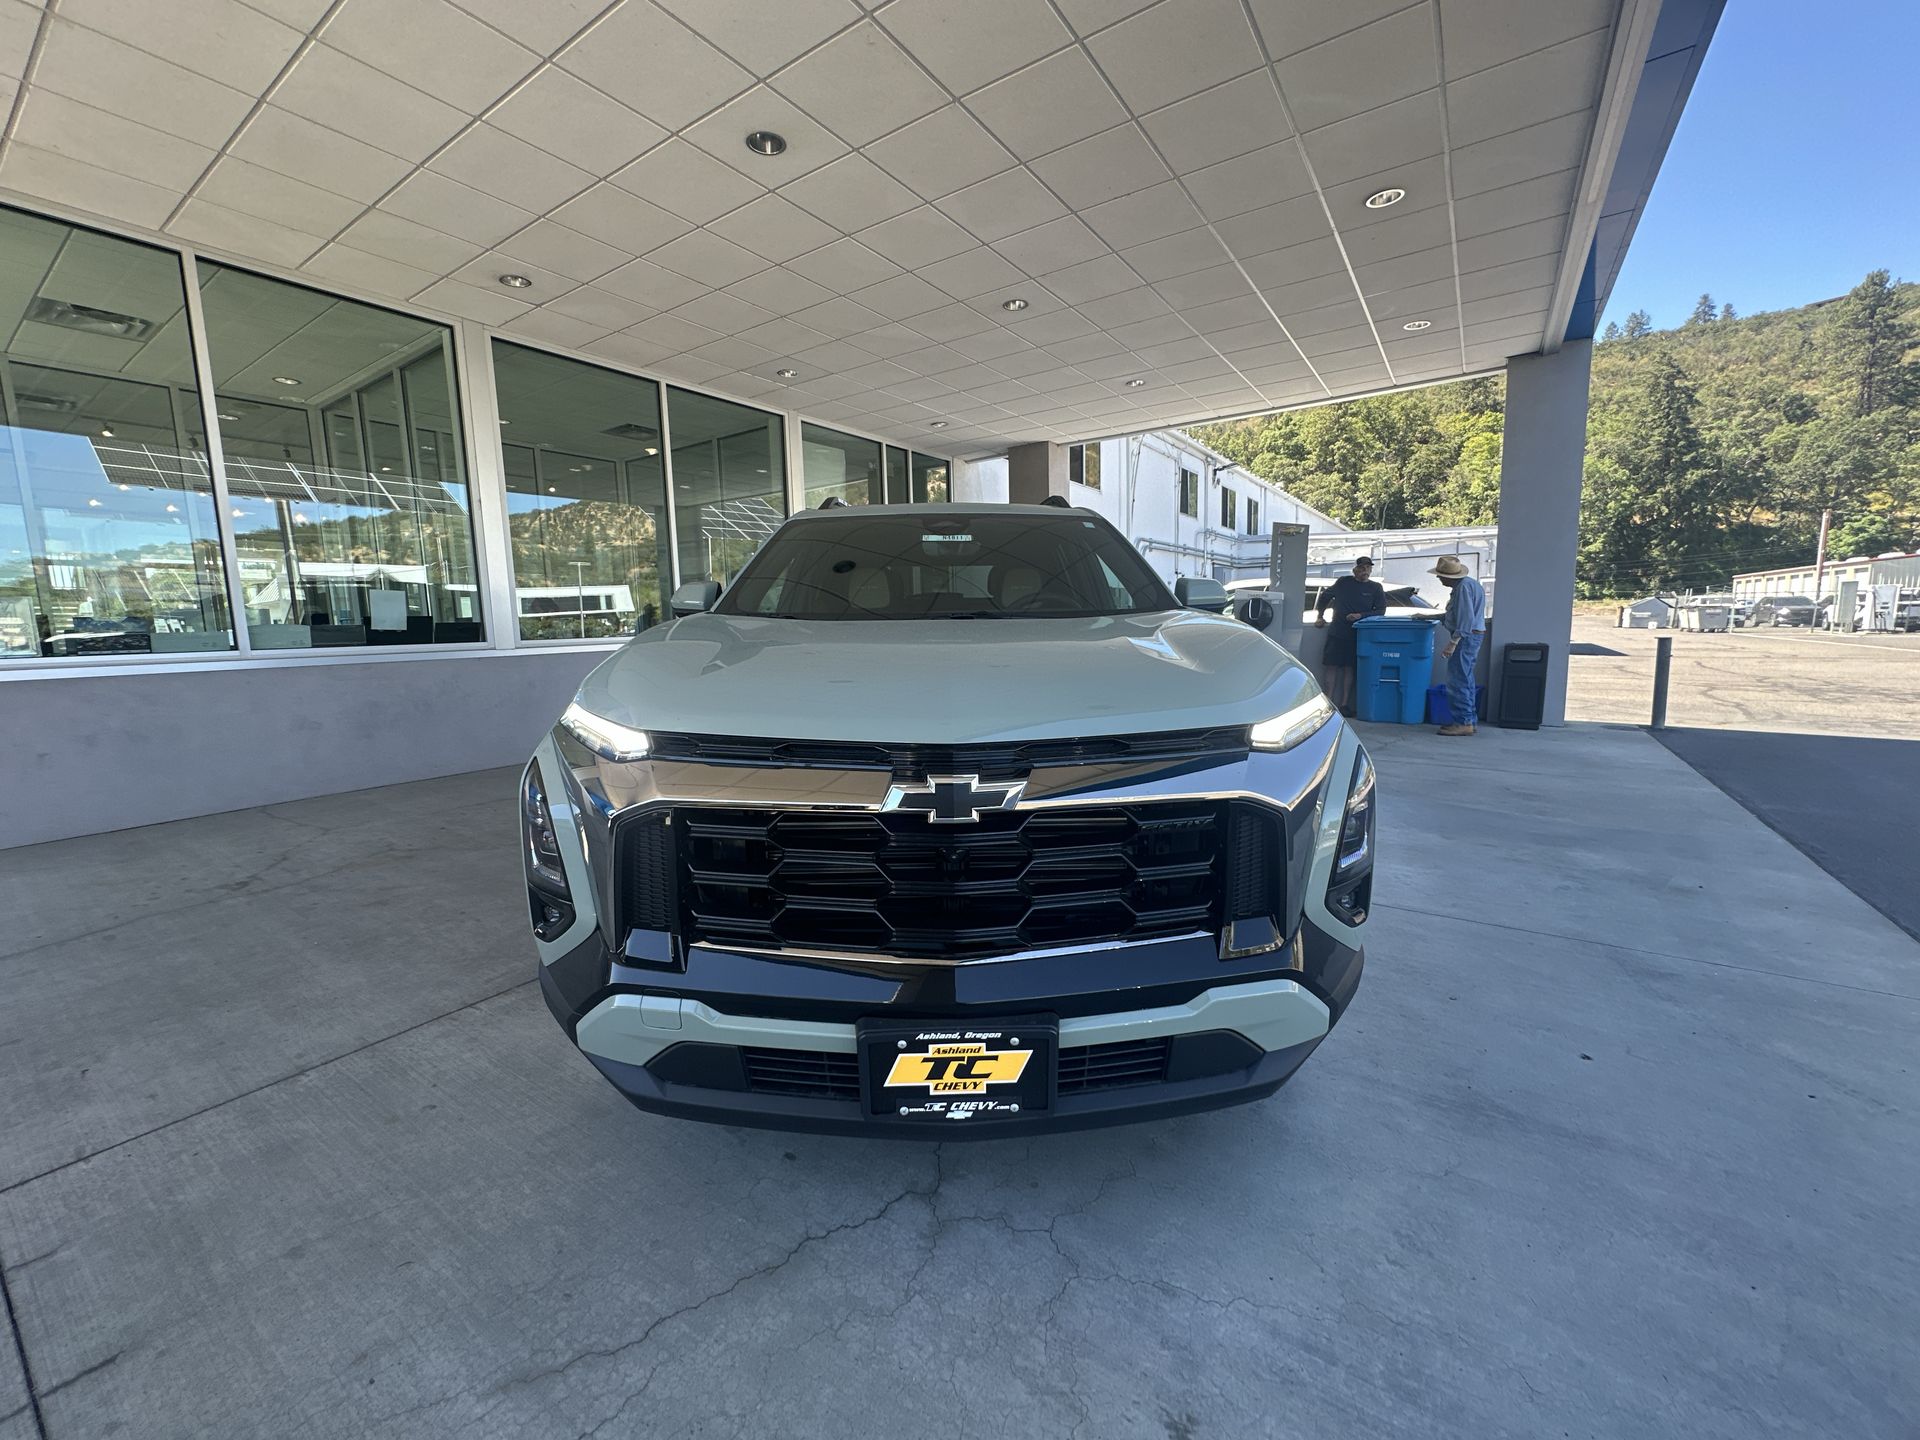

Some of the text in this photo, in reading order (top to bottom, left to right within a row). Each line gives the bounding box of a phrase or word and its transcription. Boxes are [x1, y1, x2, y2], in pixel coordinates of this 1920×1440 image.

[916, 1032, 961, 1040] Ashland,
[932, 1046, 982, 1055] Ashland
[921, 1055, 999, 1080] TC
[934, 1081, 982, 1091] CHEVY
